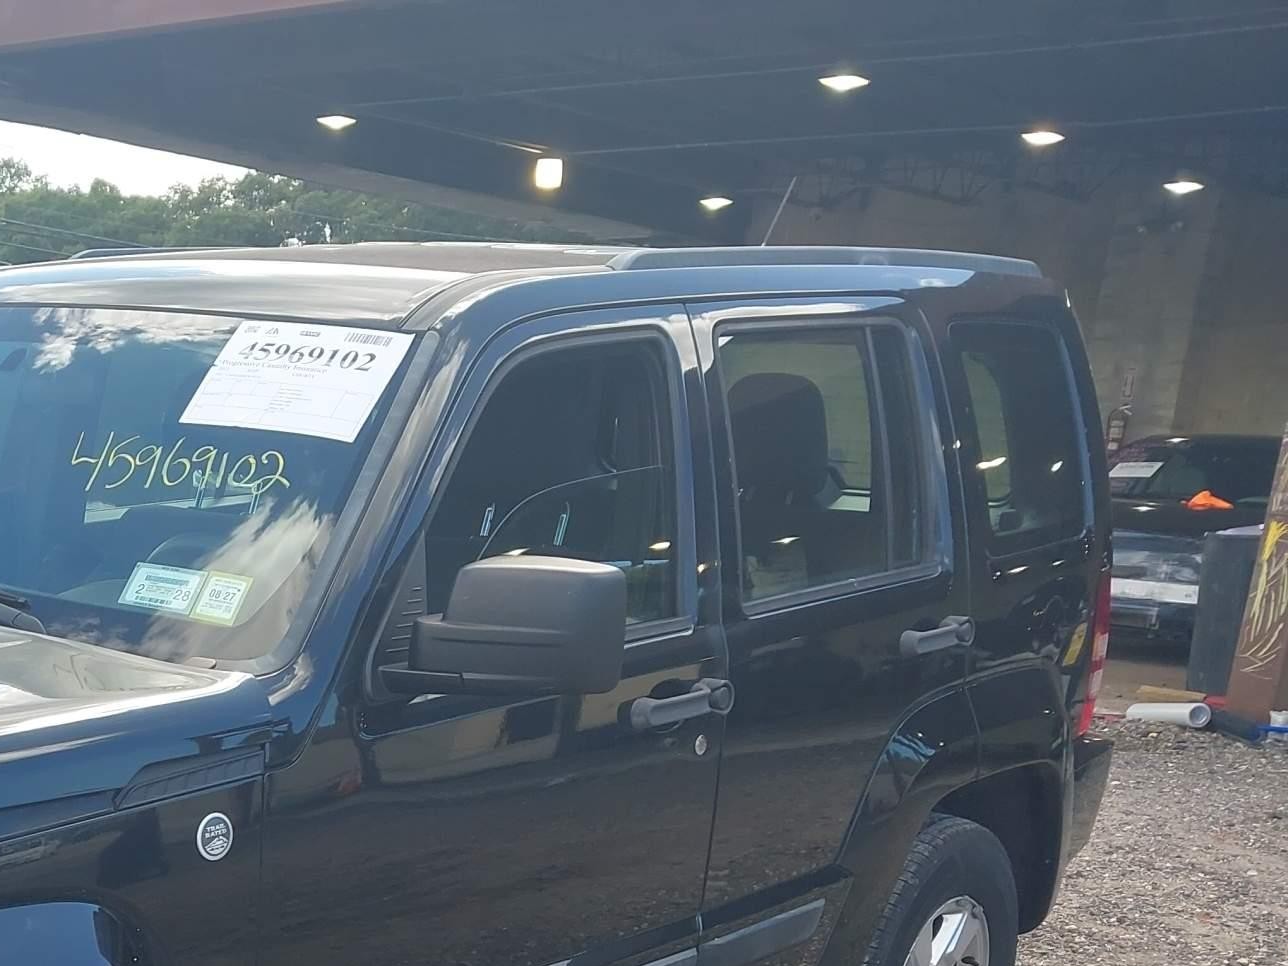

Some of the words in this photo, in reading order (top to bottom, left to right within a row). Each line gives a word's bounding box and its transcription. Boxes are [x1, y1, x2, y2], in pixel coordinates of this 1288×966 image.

[239, 341, 377, 372] 45969102
[71, 431, 291, 494] 45969102
[172, 588, 192, 602] 28
[204, 828, 227, 839] RATED
